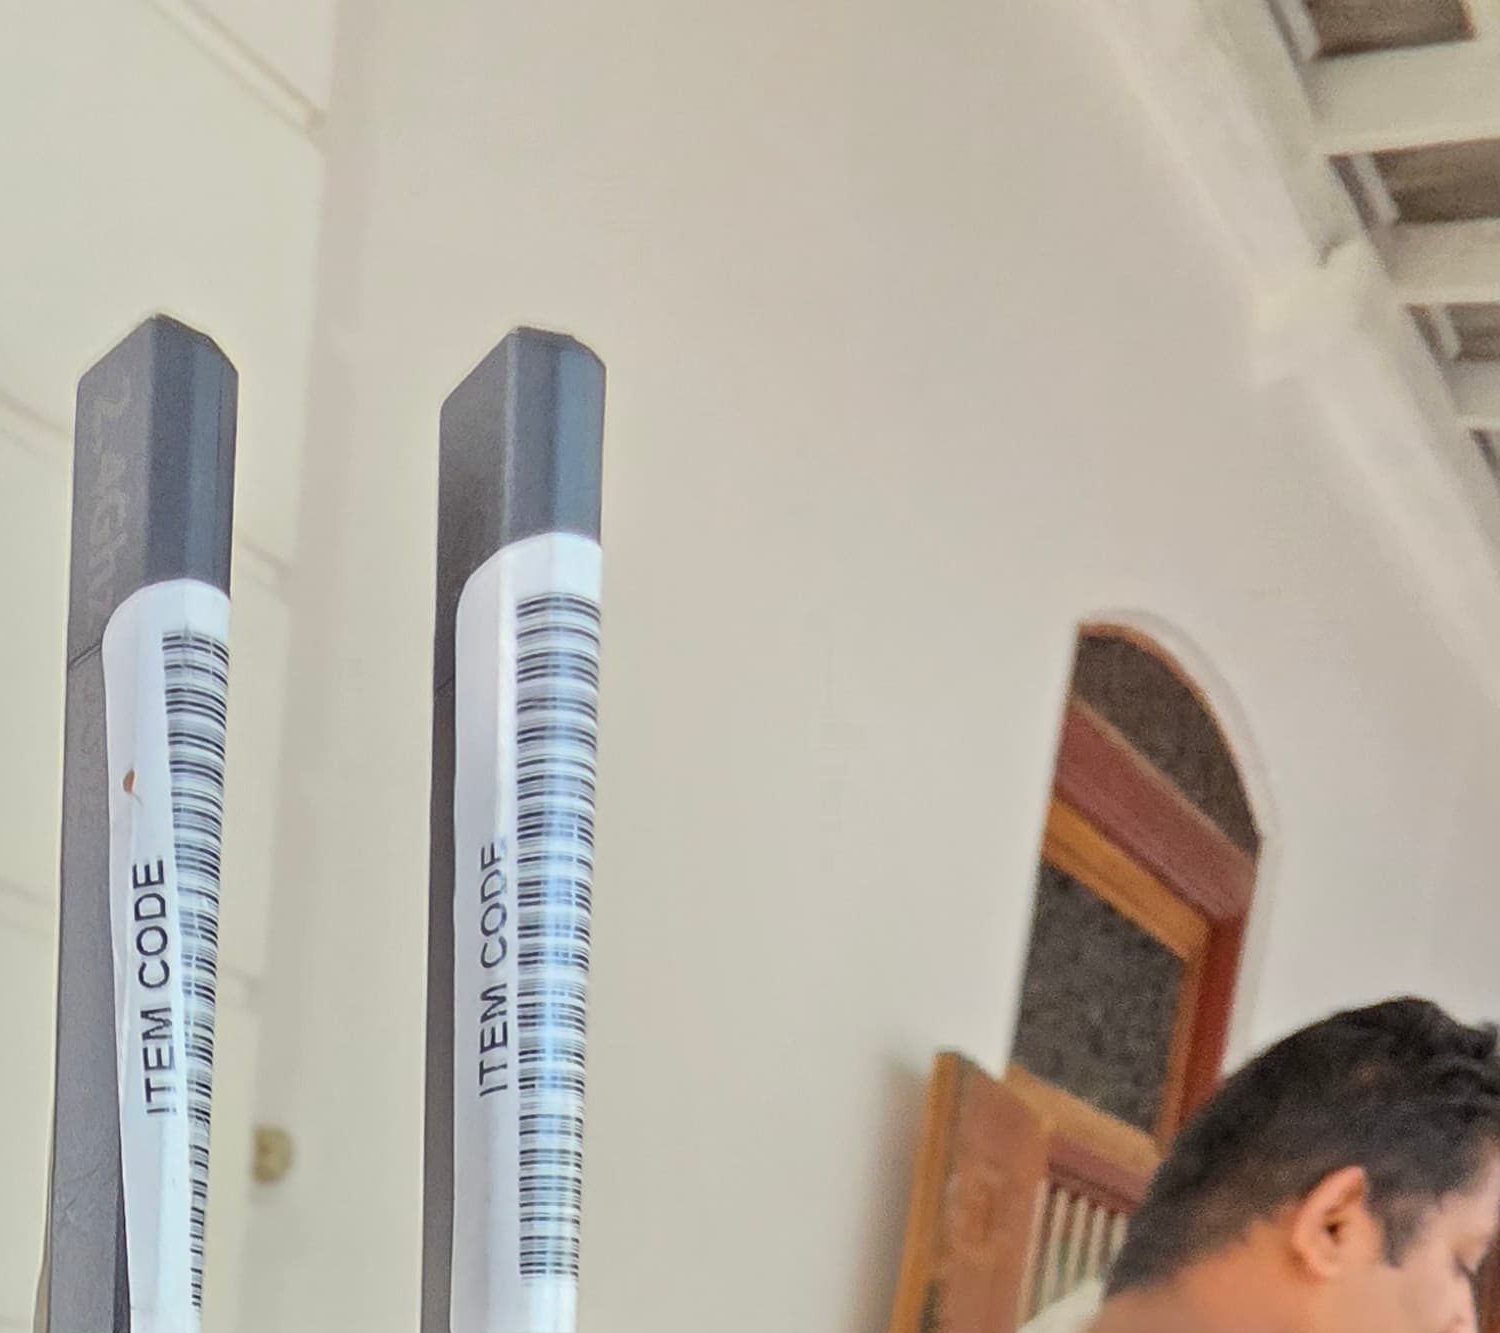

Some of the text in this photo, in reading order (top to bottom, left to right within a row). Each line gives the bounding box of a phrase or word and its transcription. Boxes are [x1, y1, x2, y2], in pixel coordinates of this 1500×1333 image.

[131, 859, 176, 1115] ITEM CODE
[479, 840, 508, 1097] ITEM CODE
